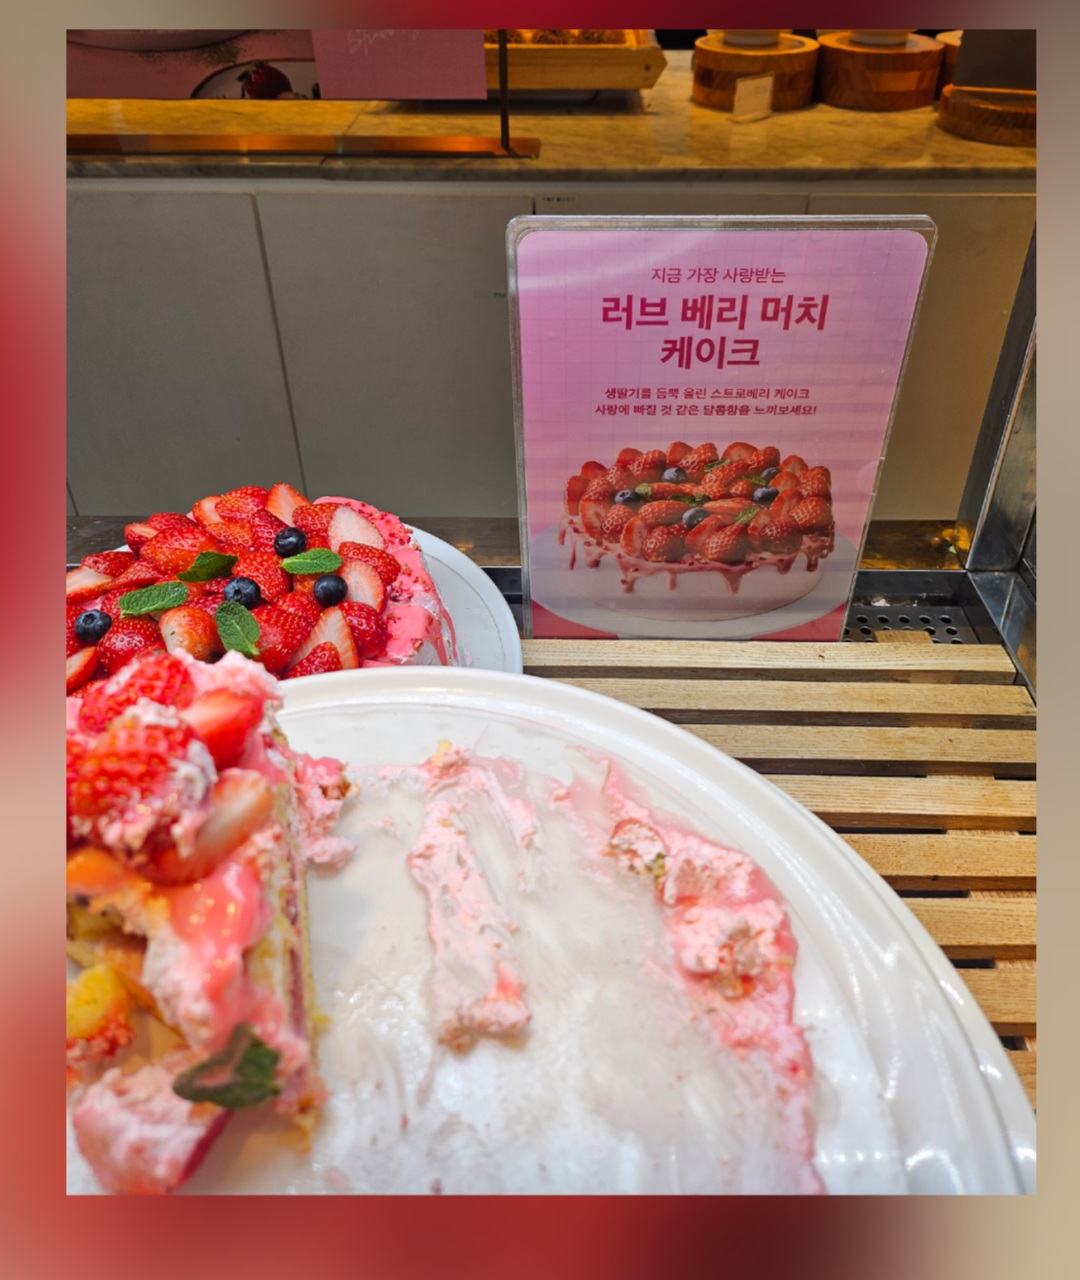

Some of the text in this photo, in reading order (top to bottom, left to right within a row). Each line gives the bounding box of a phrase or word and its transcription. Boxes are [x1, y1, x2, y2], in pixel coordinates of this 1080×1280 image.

[651, 268, 786, 284] 지금 가장 사랑받는
[602, 295, 829, 330] 러브 베리 머치
[660, 336, 760, 369] 케이크
[604, 387, 810, 399] 생딸기를 듬뿍 올린 스트로베리 케이크
[595, 405, 817, 416] 사랑에 빠질 것 같은 달콤함을 느껴보세요!
